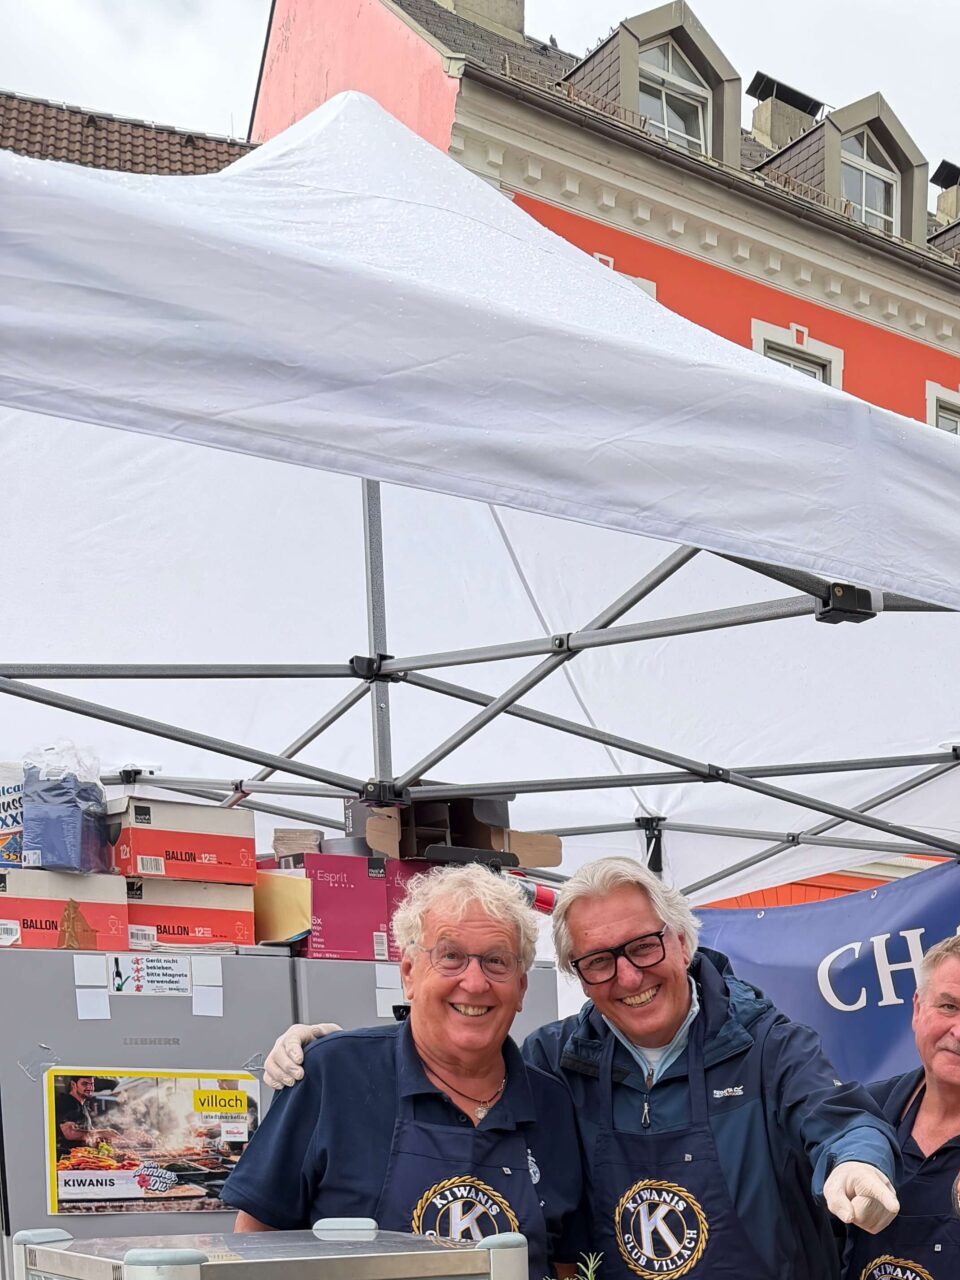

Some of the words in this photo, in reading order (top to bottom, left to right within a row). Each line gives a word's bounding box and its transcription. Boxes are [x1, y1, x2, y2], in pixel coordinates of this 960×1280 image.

[165, 850, 196, 862] BALLON
[22, 918, 58, 930] BALLON
[157, 924, 189, 936] BALLON
[199, 1095, 243, 1108] villach
[63, 1178, 116, 1189] KIWANIS
[431, 1186, 500, 1216] KIWANIS
[626, 1189, 687, 1212] KIWANIS
[449, 1200, 485, 1241] K
[639, 1202, 681, 1259] K
[624, 1233, 648, 1266] CLUB
[653, 1229, 697, 1271] VILLACH
